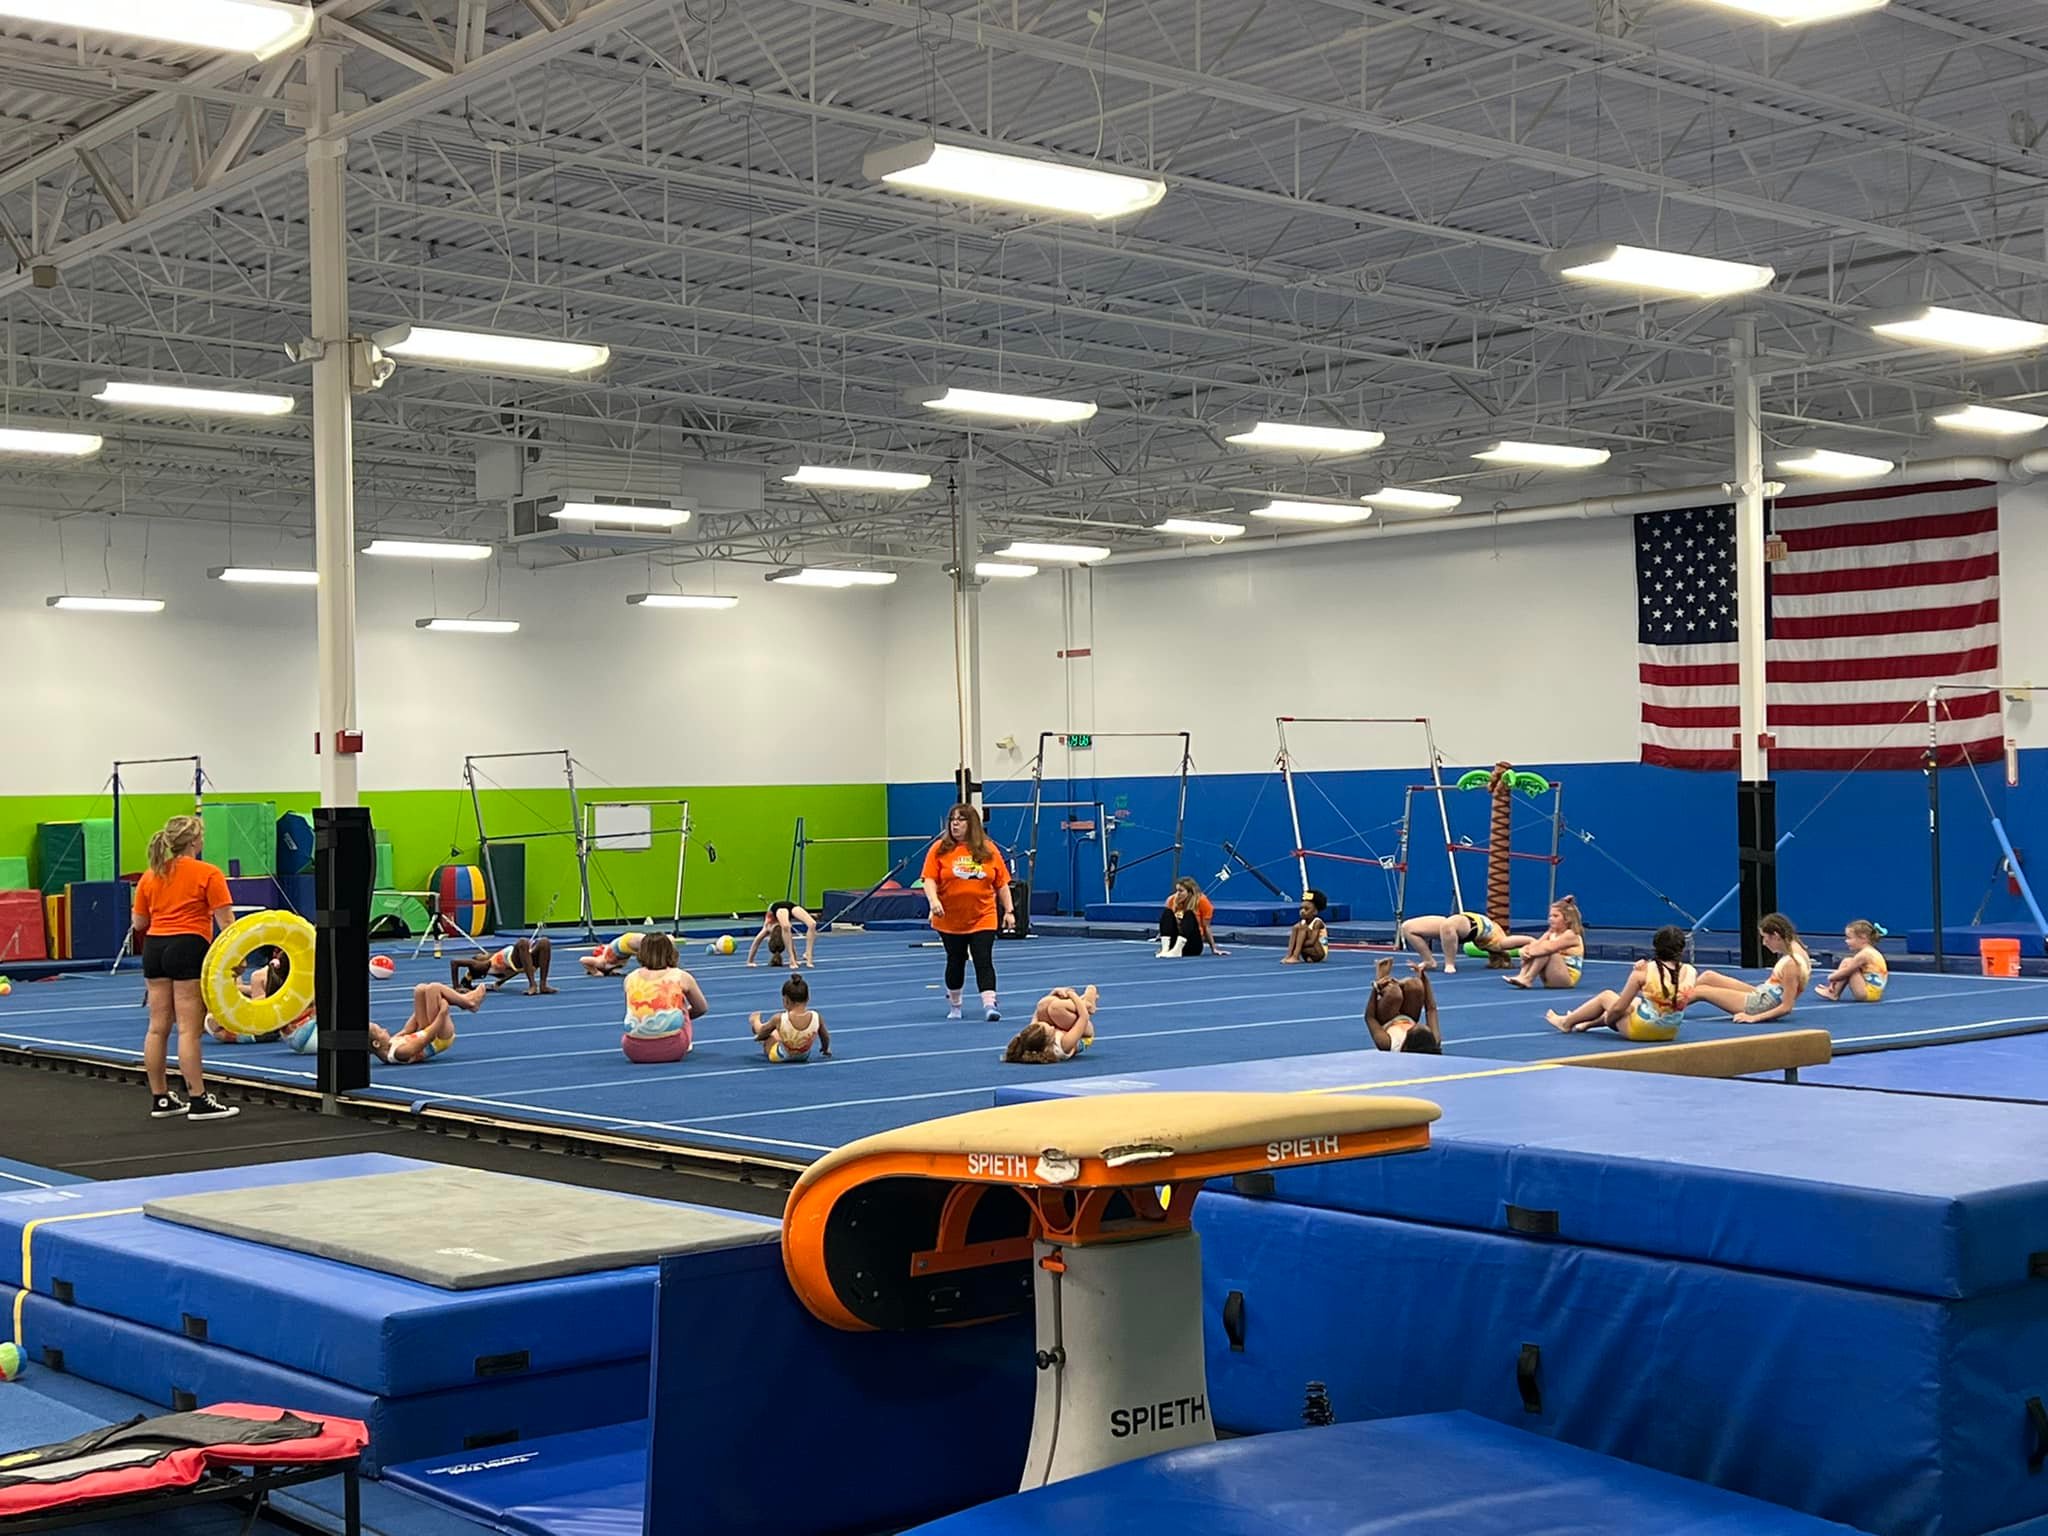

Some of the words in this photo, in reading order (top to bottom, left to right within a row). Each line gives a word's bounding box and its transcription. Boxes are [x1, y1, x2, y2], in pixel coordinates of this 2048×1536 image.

[1267, 1135, 1339, 1162] SPIETH
[968, 1153, 1028, 1178] SPIETH
[1111, 1394, 1205, 1437] SPIETH
